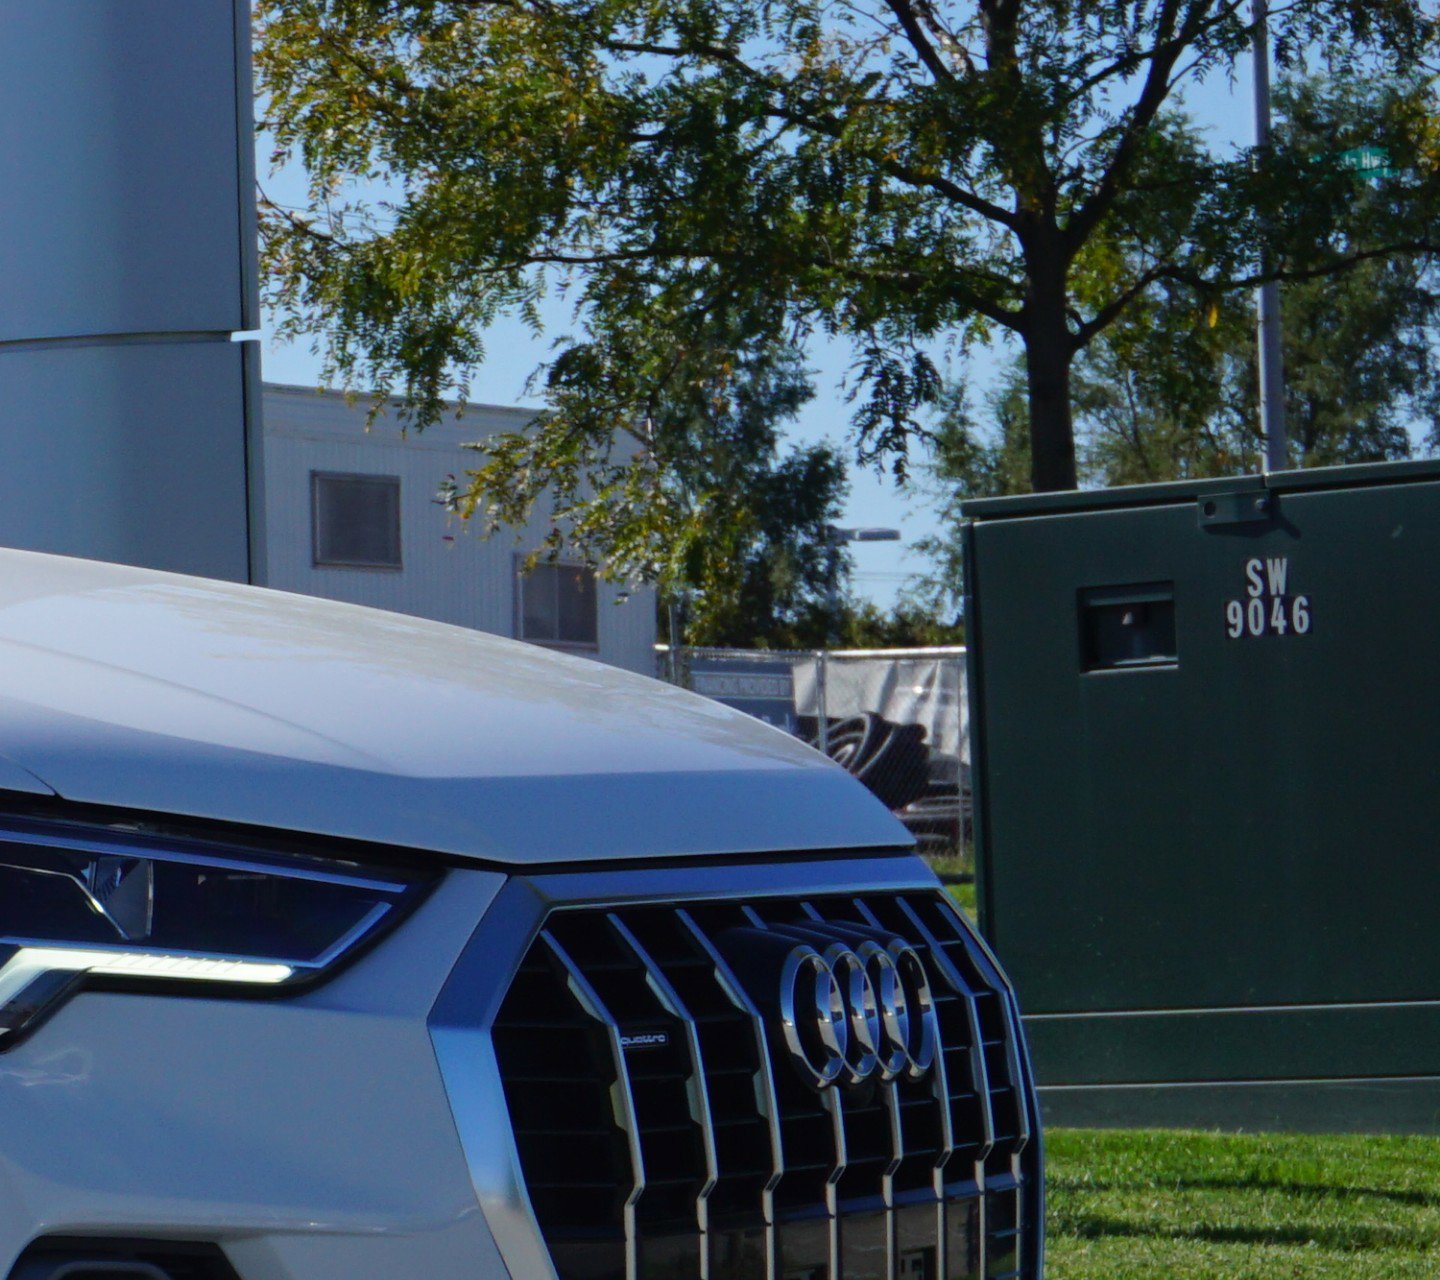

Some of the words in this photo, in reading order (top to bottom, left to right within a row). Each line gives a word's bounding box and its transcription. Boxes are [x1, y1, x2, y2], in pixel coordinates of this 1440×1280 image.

[1245, 557, 1288, 597] SW
[1226, 596, 1310, 639] 9046
[620, 1034, 666, 1048] quattro
